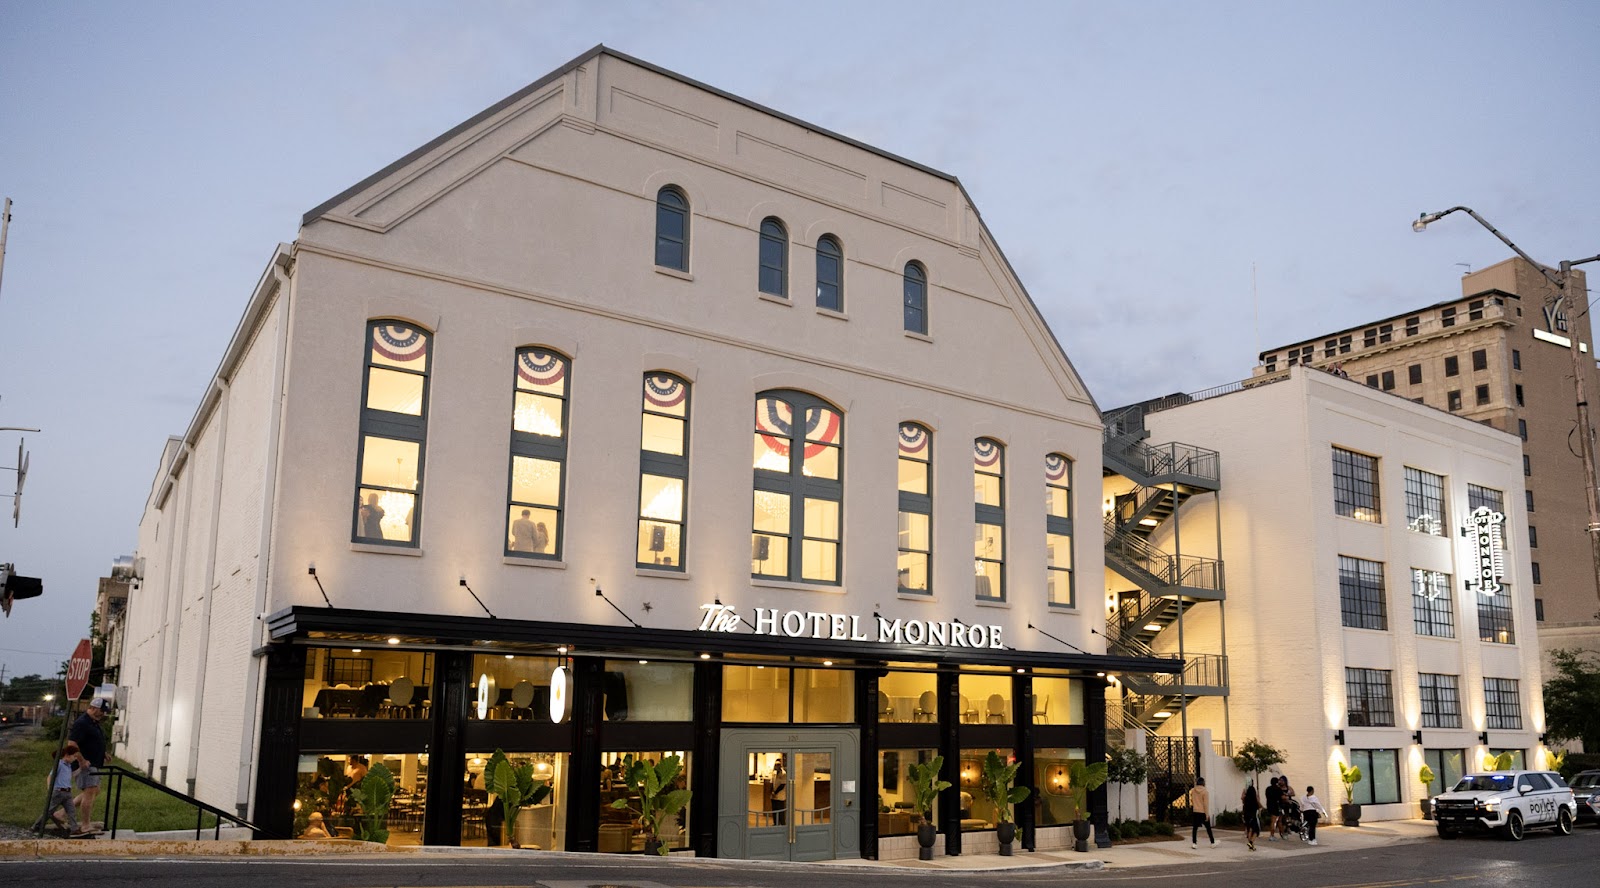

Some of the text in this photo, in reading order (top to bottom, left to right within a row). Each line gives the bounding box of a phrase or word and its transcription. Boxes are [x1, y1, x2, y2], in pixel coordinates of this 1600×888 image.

[1465, 513, 1500, 525] HOTEL
[1478, 524, 1493, 589] MONROE
[698, 603, 1003, 650] The HOTEL MONROE
[69, 658, 91, 680] STOP
[1529, 801, 1556, 814] POLICE
